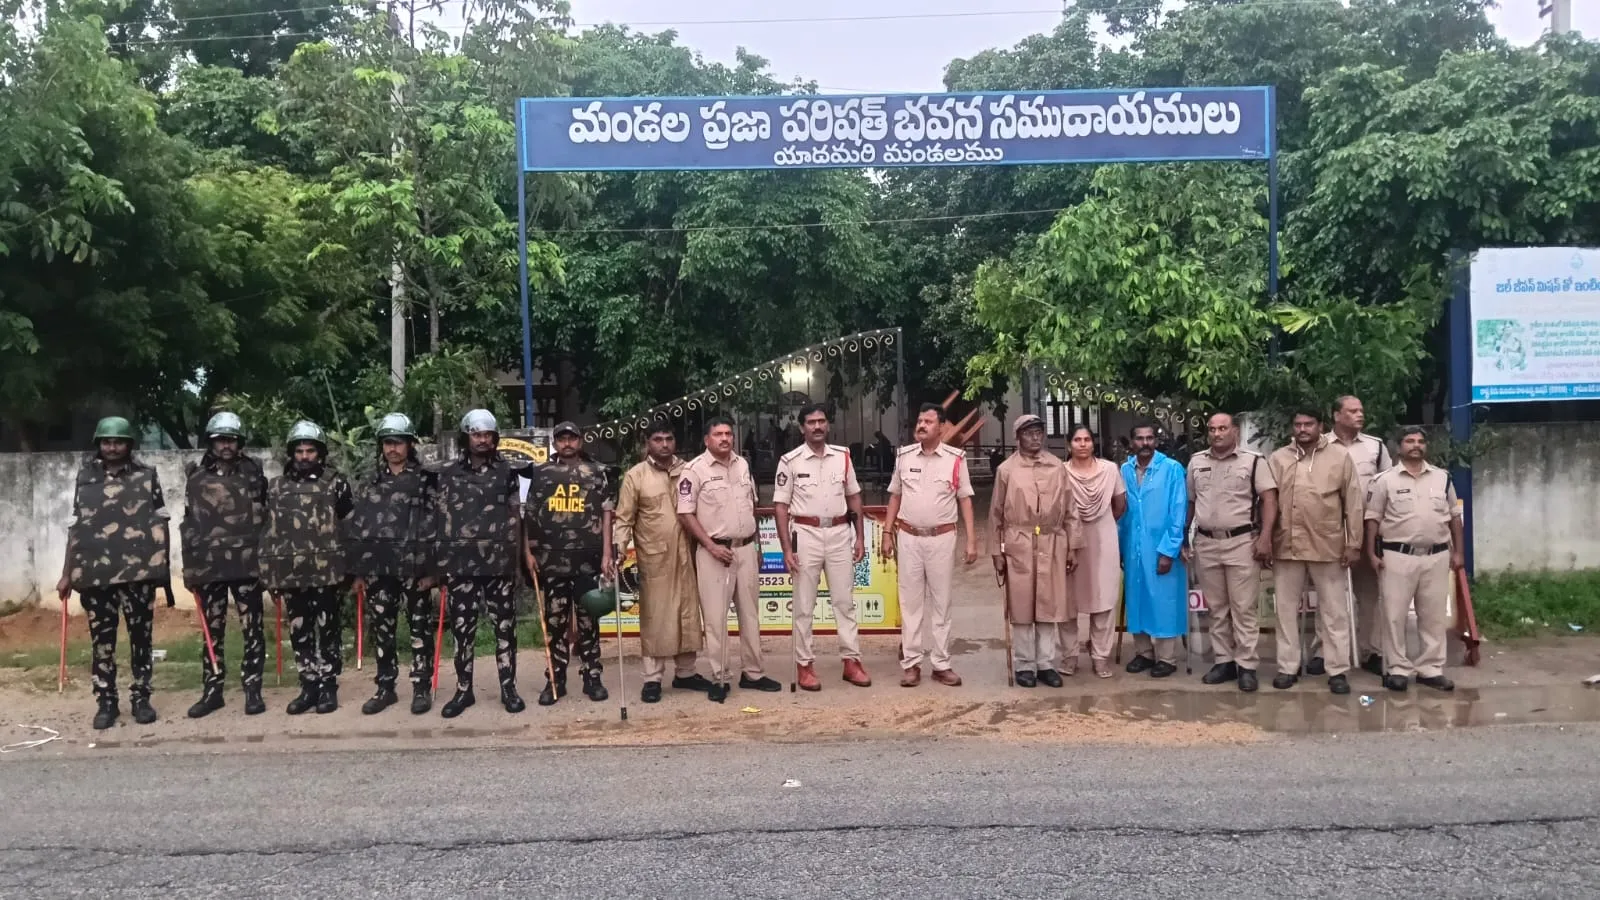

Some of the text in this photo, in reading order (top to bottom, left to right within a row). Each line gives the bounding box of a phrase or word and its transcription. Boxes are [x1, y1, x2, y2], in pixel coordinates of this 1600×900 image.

[568, 90, 1241, 150] మండల ప్రజా పరిషత్ భవన సముదాయములు
[773, 141, 1004, 165] యాదమరి మండలము
[548, 497, 585, 513] POLICE
